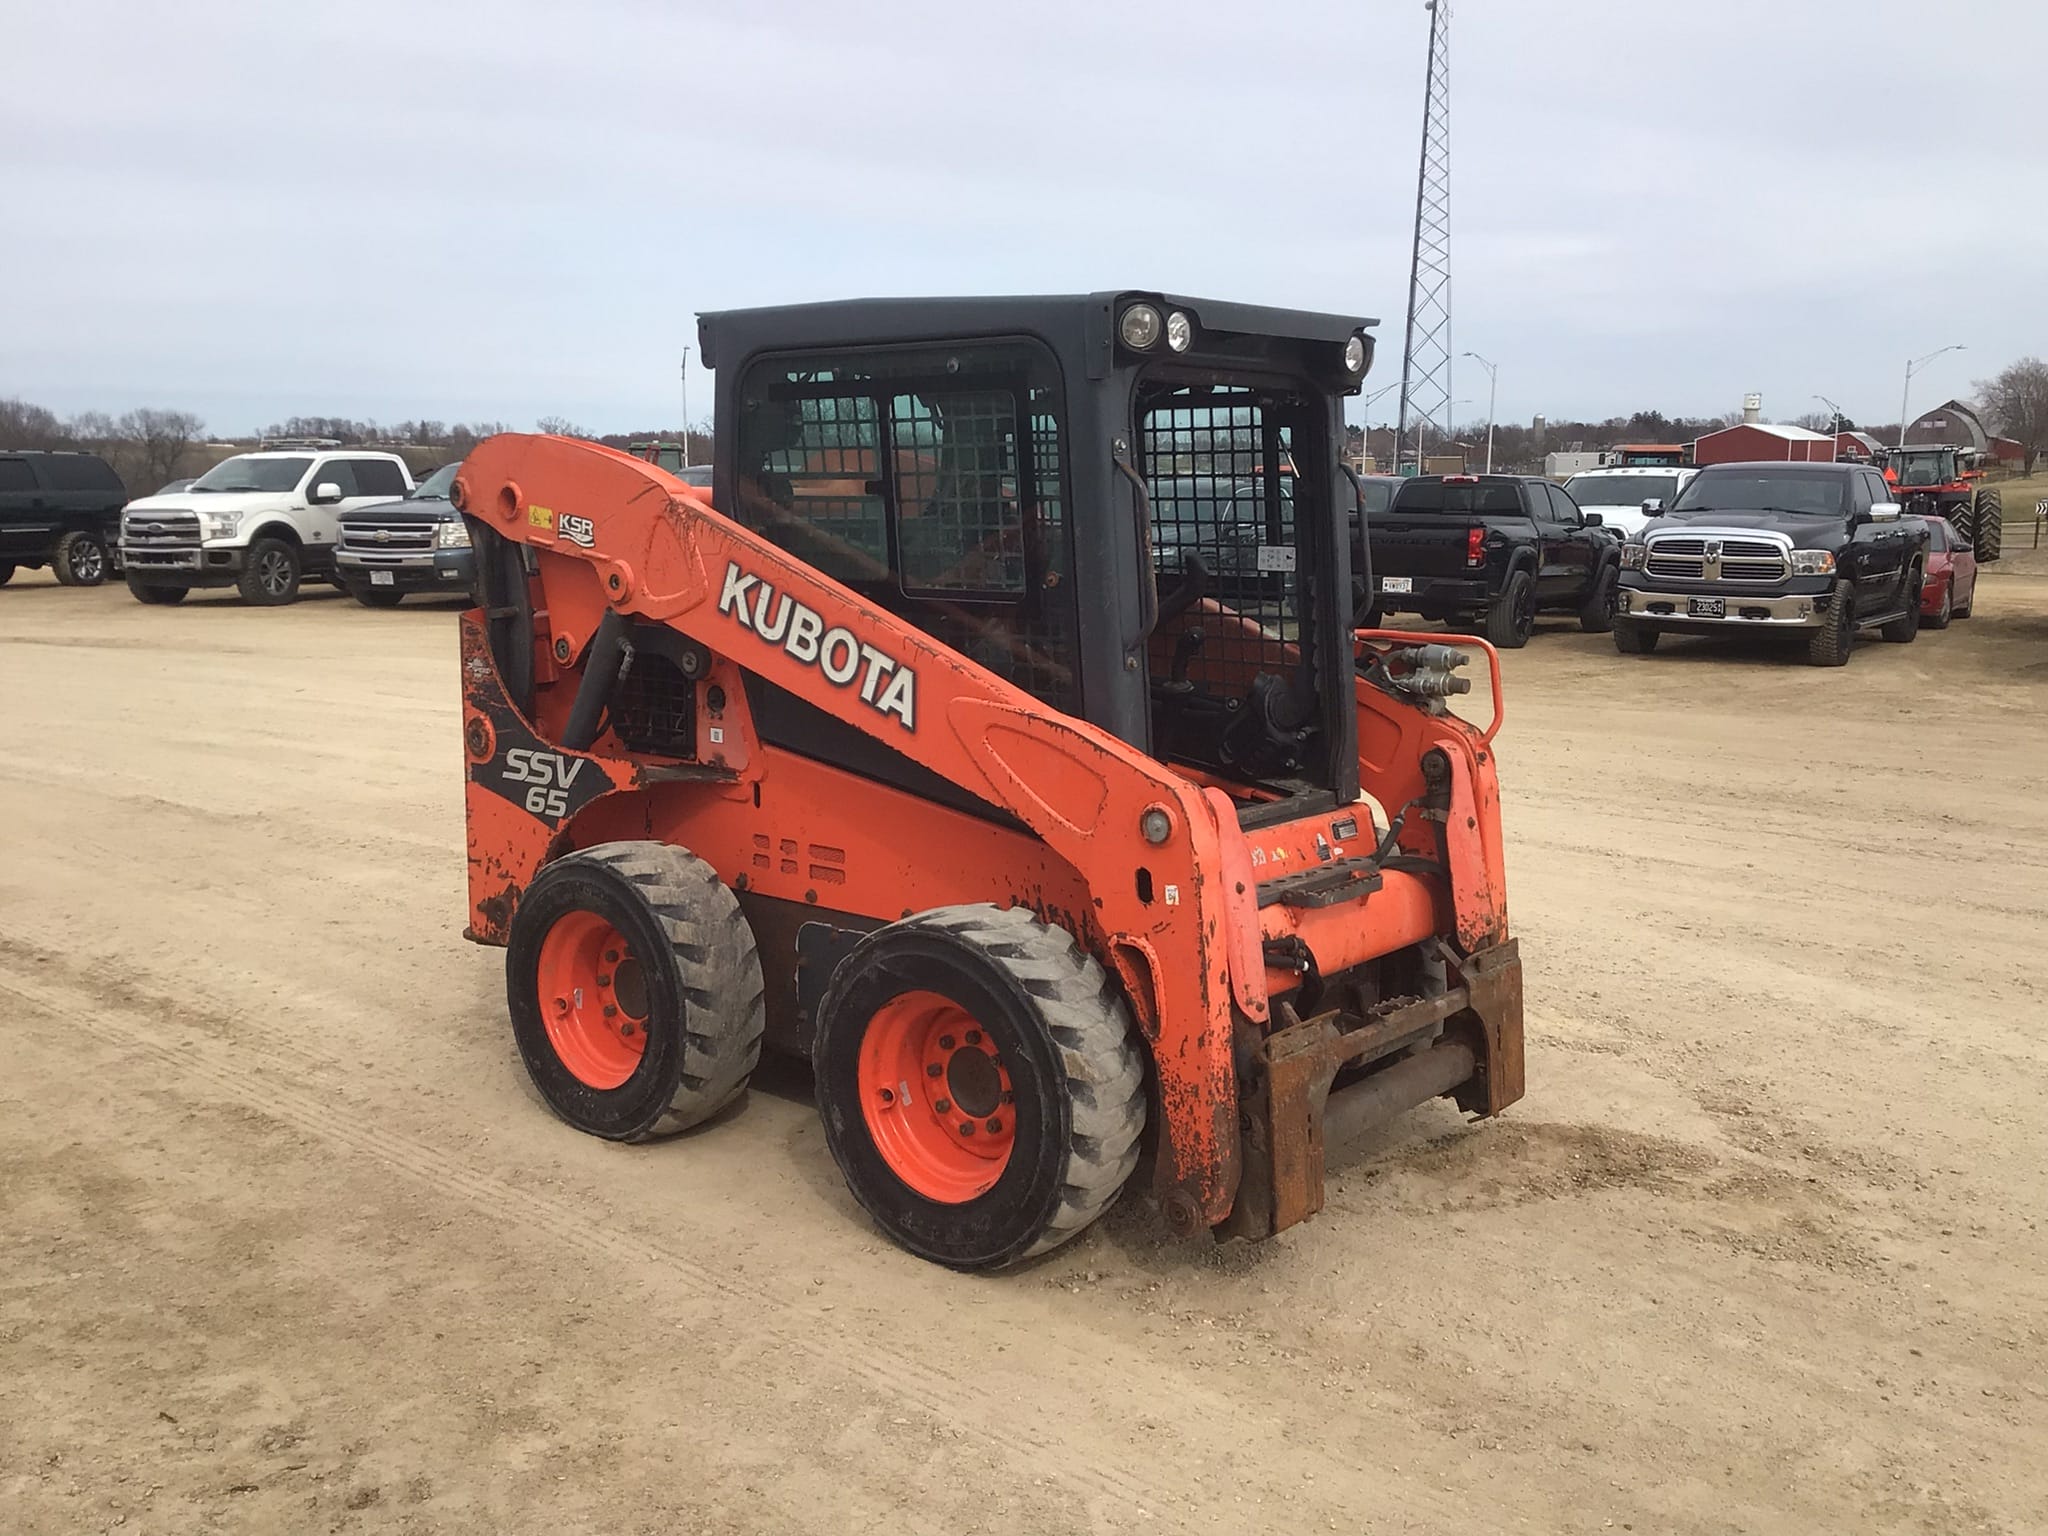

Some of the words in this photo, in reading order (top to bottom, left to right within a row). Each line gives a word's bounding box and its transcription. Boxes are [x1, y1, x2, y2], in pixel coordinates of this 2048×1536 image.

[559, 513, 593, 535] KSR
[718, 561, 916, 732] KUBOTA
[502, 747, 585, 789] SSV
[525, 786, 569, 817] 65
